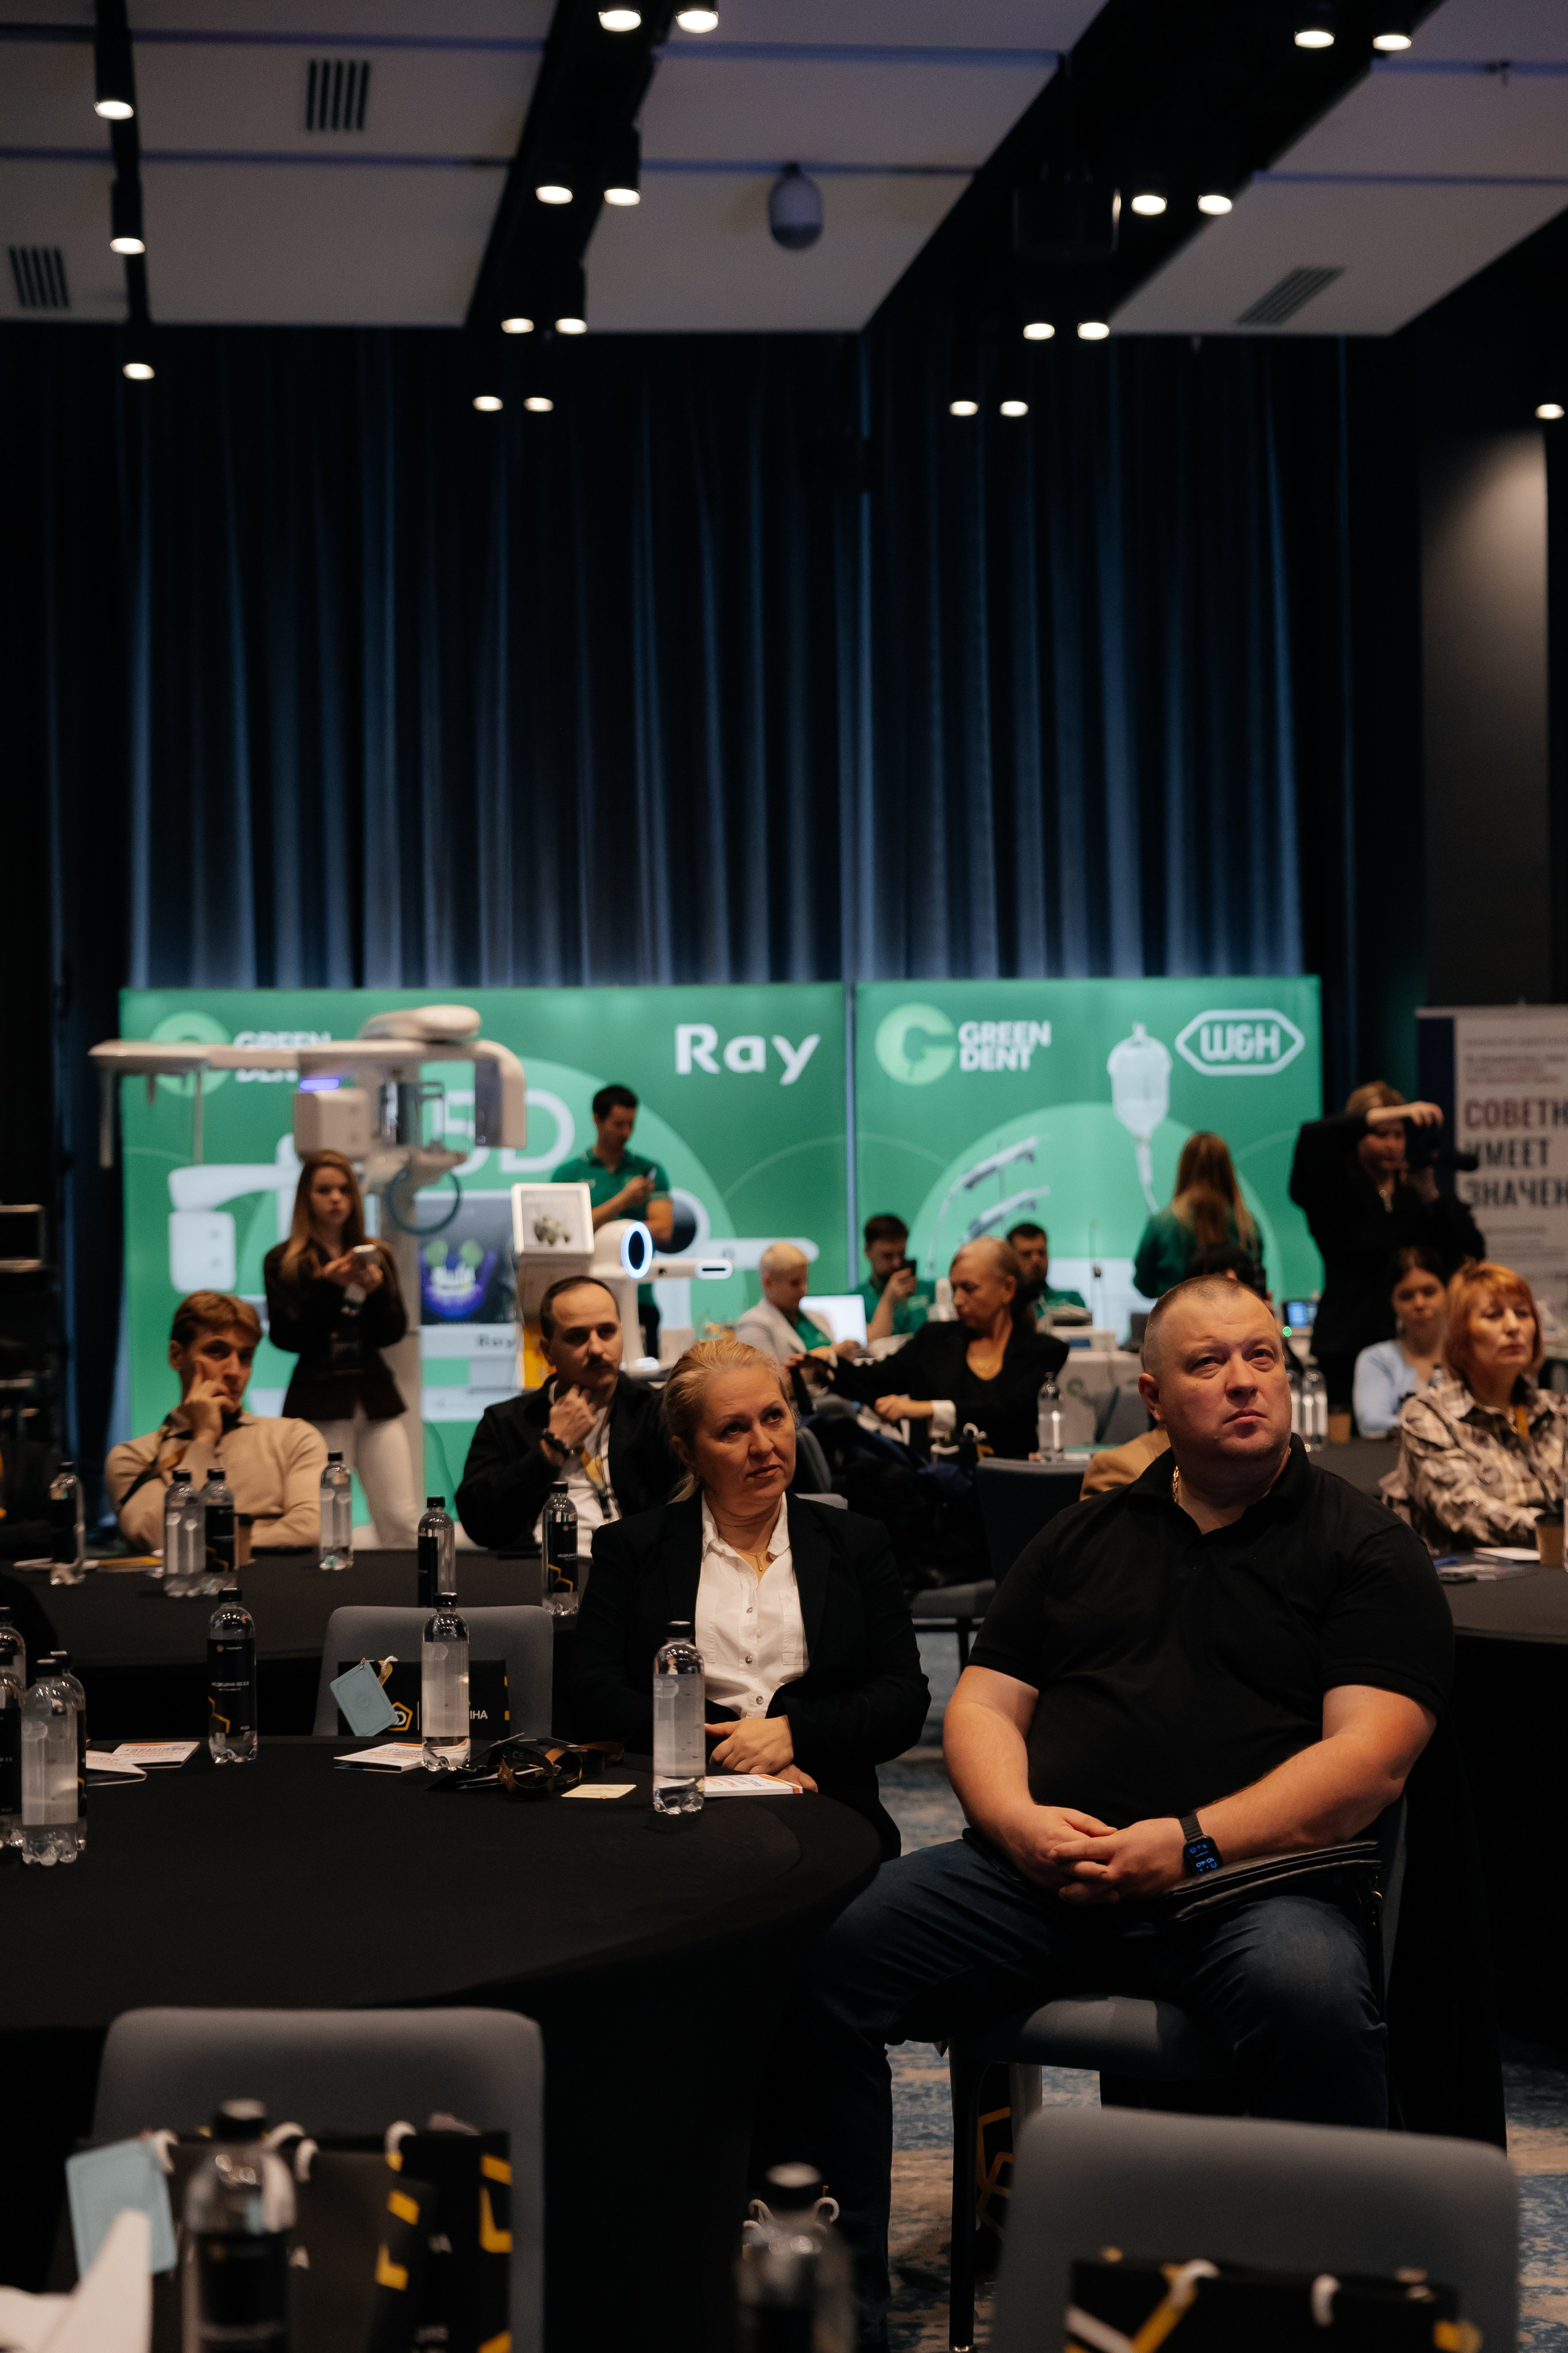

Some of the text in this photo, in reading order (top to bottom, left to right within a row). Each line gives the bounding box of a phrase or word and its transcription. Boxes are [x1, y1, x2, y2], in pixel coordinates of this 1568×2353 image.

[958, 1021, 1052, 1048] GREEN
[675, 1024, 821, 1086] Ray
[960, 1045, 1034, 1071] DENT
